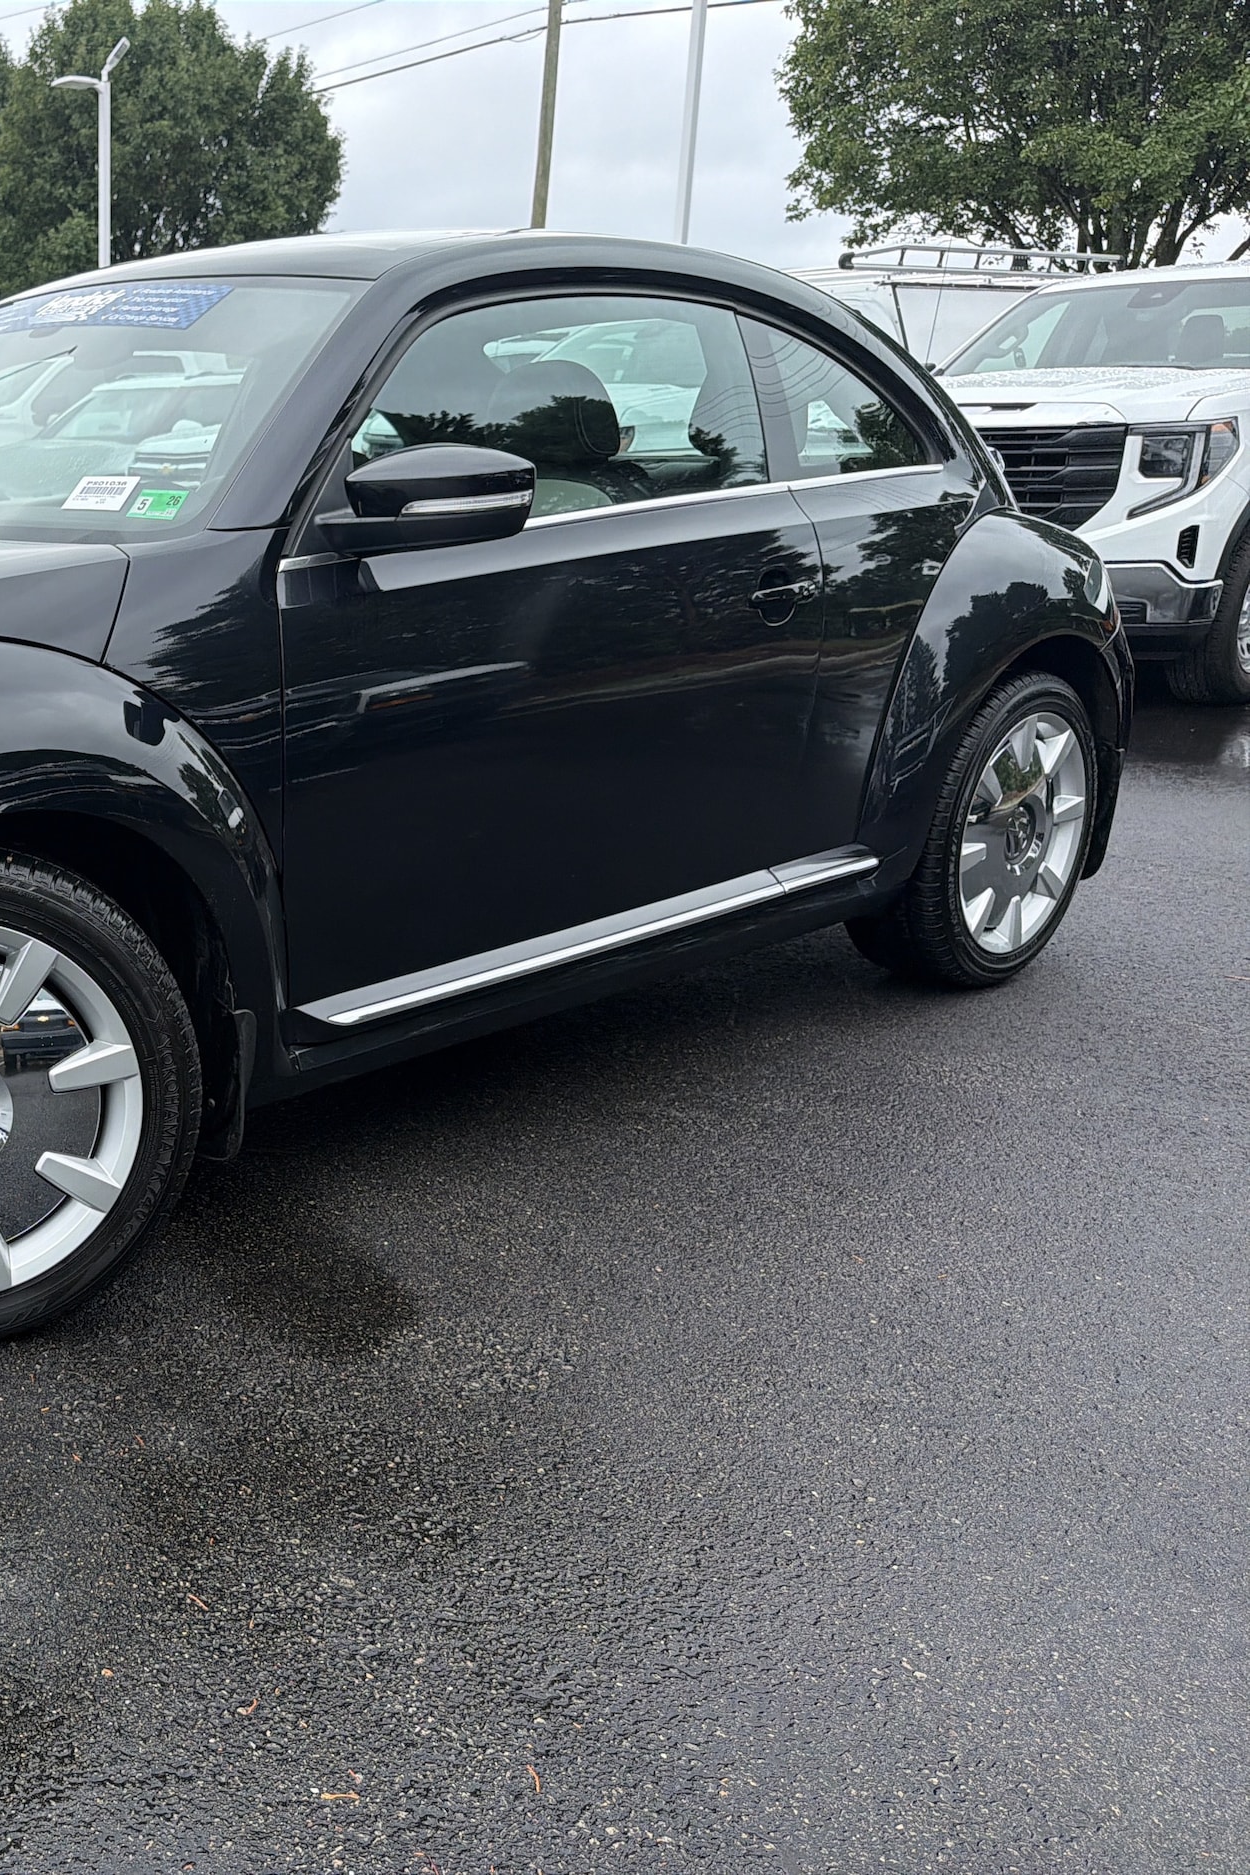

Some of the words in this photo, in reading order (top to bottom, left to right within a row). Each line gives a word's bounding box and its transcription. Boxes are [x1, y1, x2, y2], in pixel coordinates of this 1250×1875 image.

[137, 498, 150, 511] 5
[166, 495, 182, 506] 26
[157, 1036, 180, 1154] YOKOHAMA
